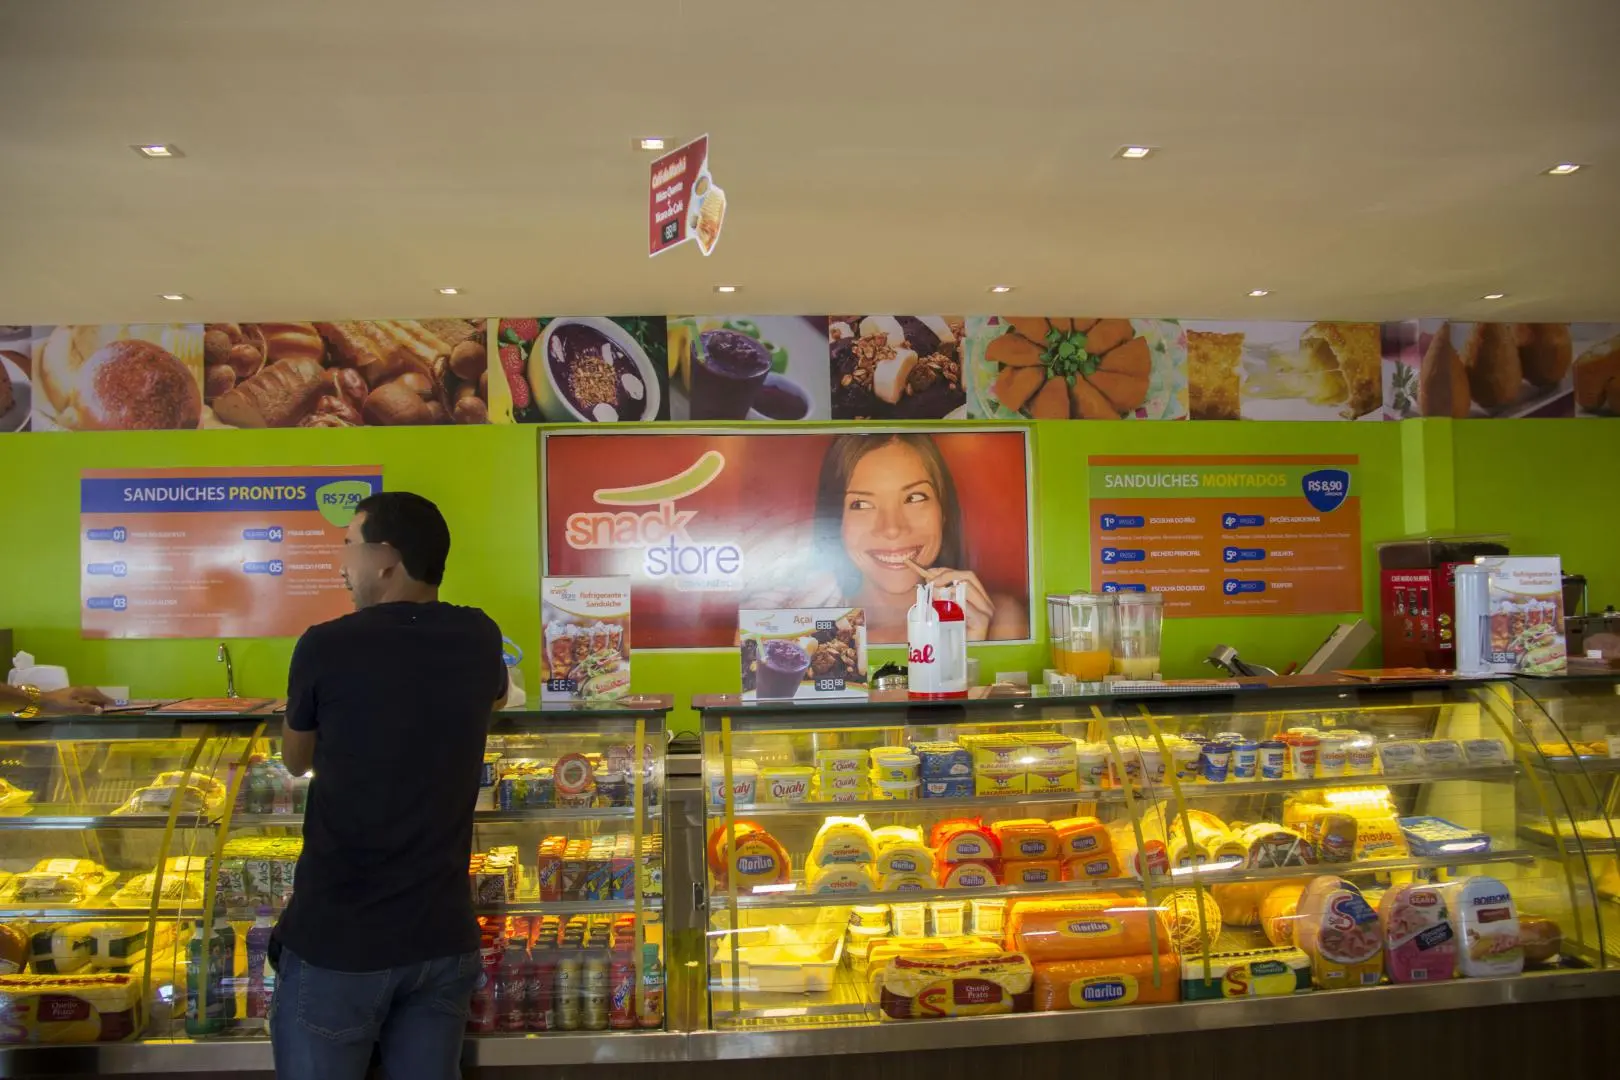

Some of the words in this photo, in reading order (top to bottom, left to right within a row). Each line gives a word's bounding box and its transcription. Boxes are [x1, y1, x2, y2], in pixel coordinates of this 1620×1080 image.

[1104, 472, 1198, 488] SANDUÍCHES
[1202, 473, 1287, 488] MONTADOS
[124, 485, 226, 502] SANDUÍCHES
[229, 486, 306, 500] PRONTOS
[567, 502, 696, 548] snack
[112, 530, 125, 540] 01
[268, 529, 282, 540] 04
[646, 534, 740, 576] store
[112, 564, 126, 574] 02
[268, 562, 282, 572] 05
[580, 592, 622, 600] Refrigerante
[112, 598, 126, 608] 03
[773, 781, 805, 798] Qualy
[1226, 966, 1248, 996] S
